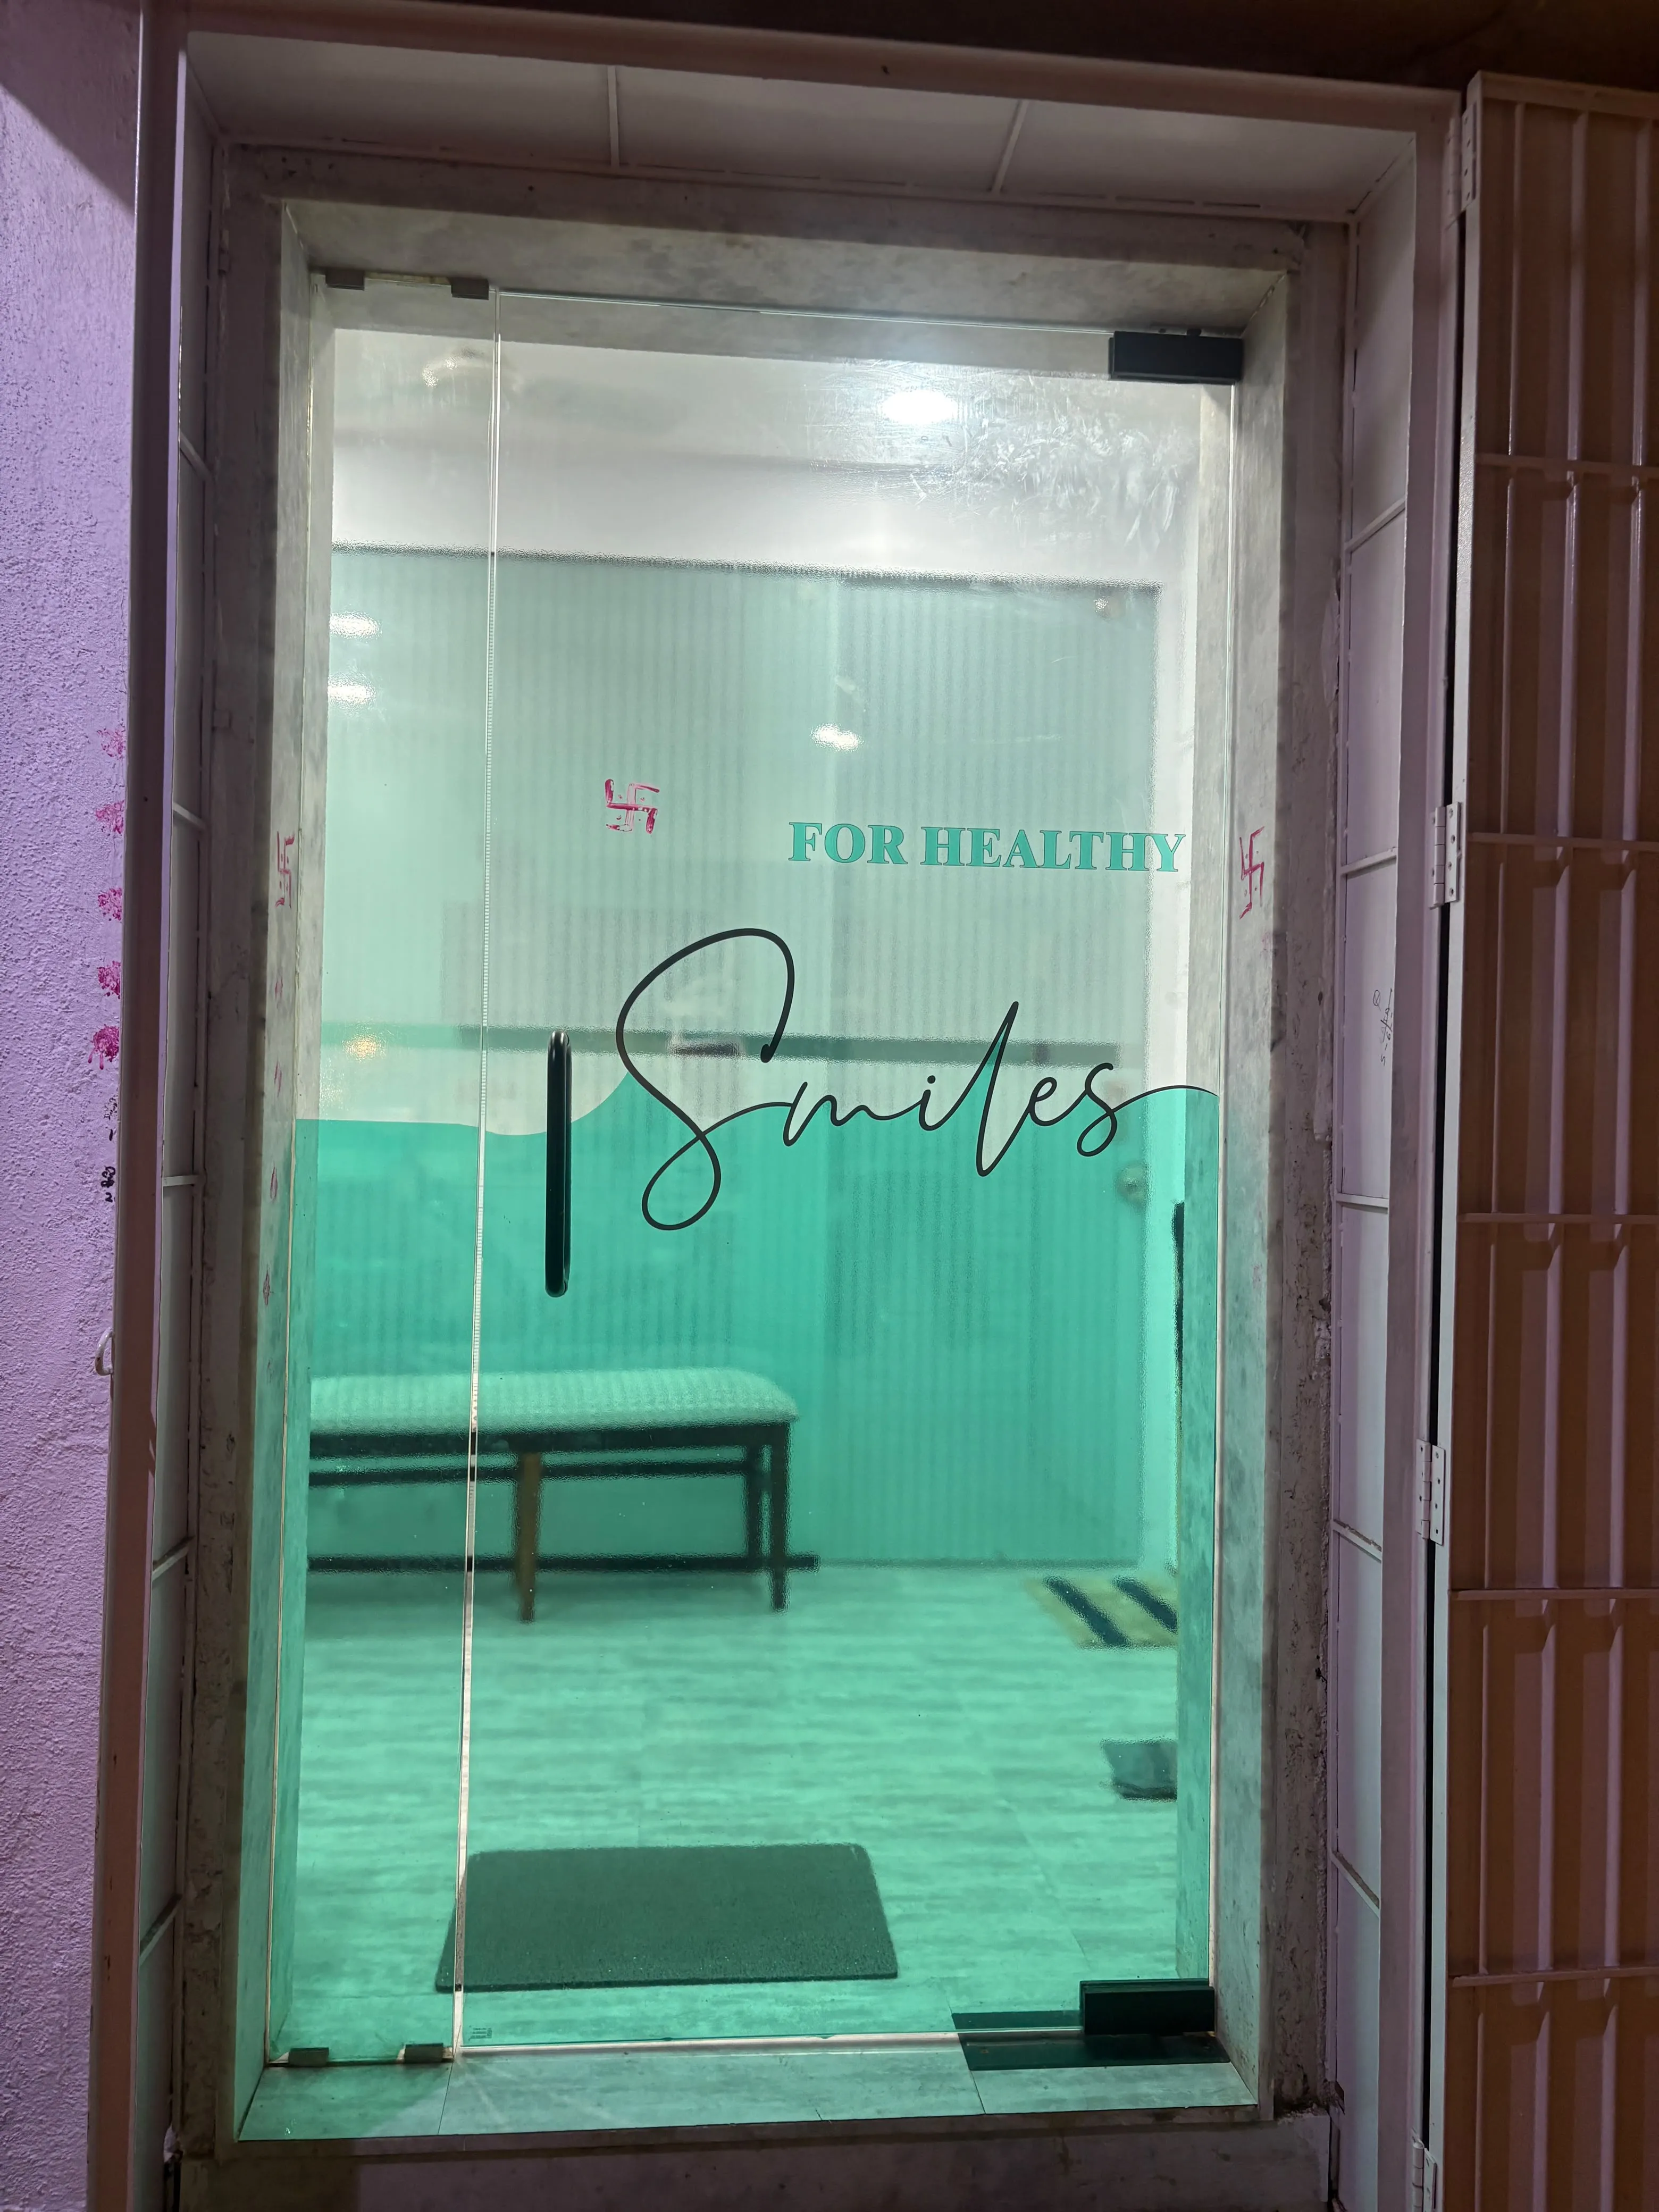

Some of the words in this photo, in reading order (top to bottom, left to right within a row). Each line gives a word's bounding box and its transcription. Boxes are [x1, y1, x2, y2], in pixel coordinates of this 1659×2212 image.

[789, 822, 908, 865] FOR
[920, 826, 1186, 872] HEALTHY
[616, 928, 1218, 1231] Smiles
